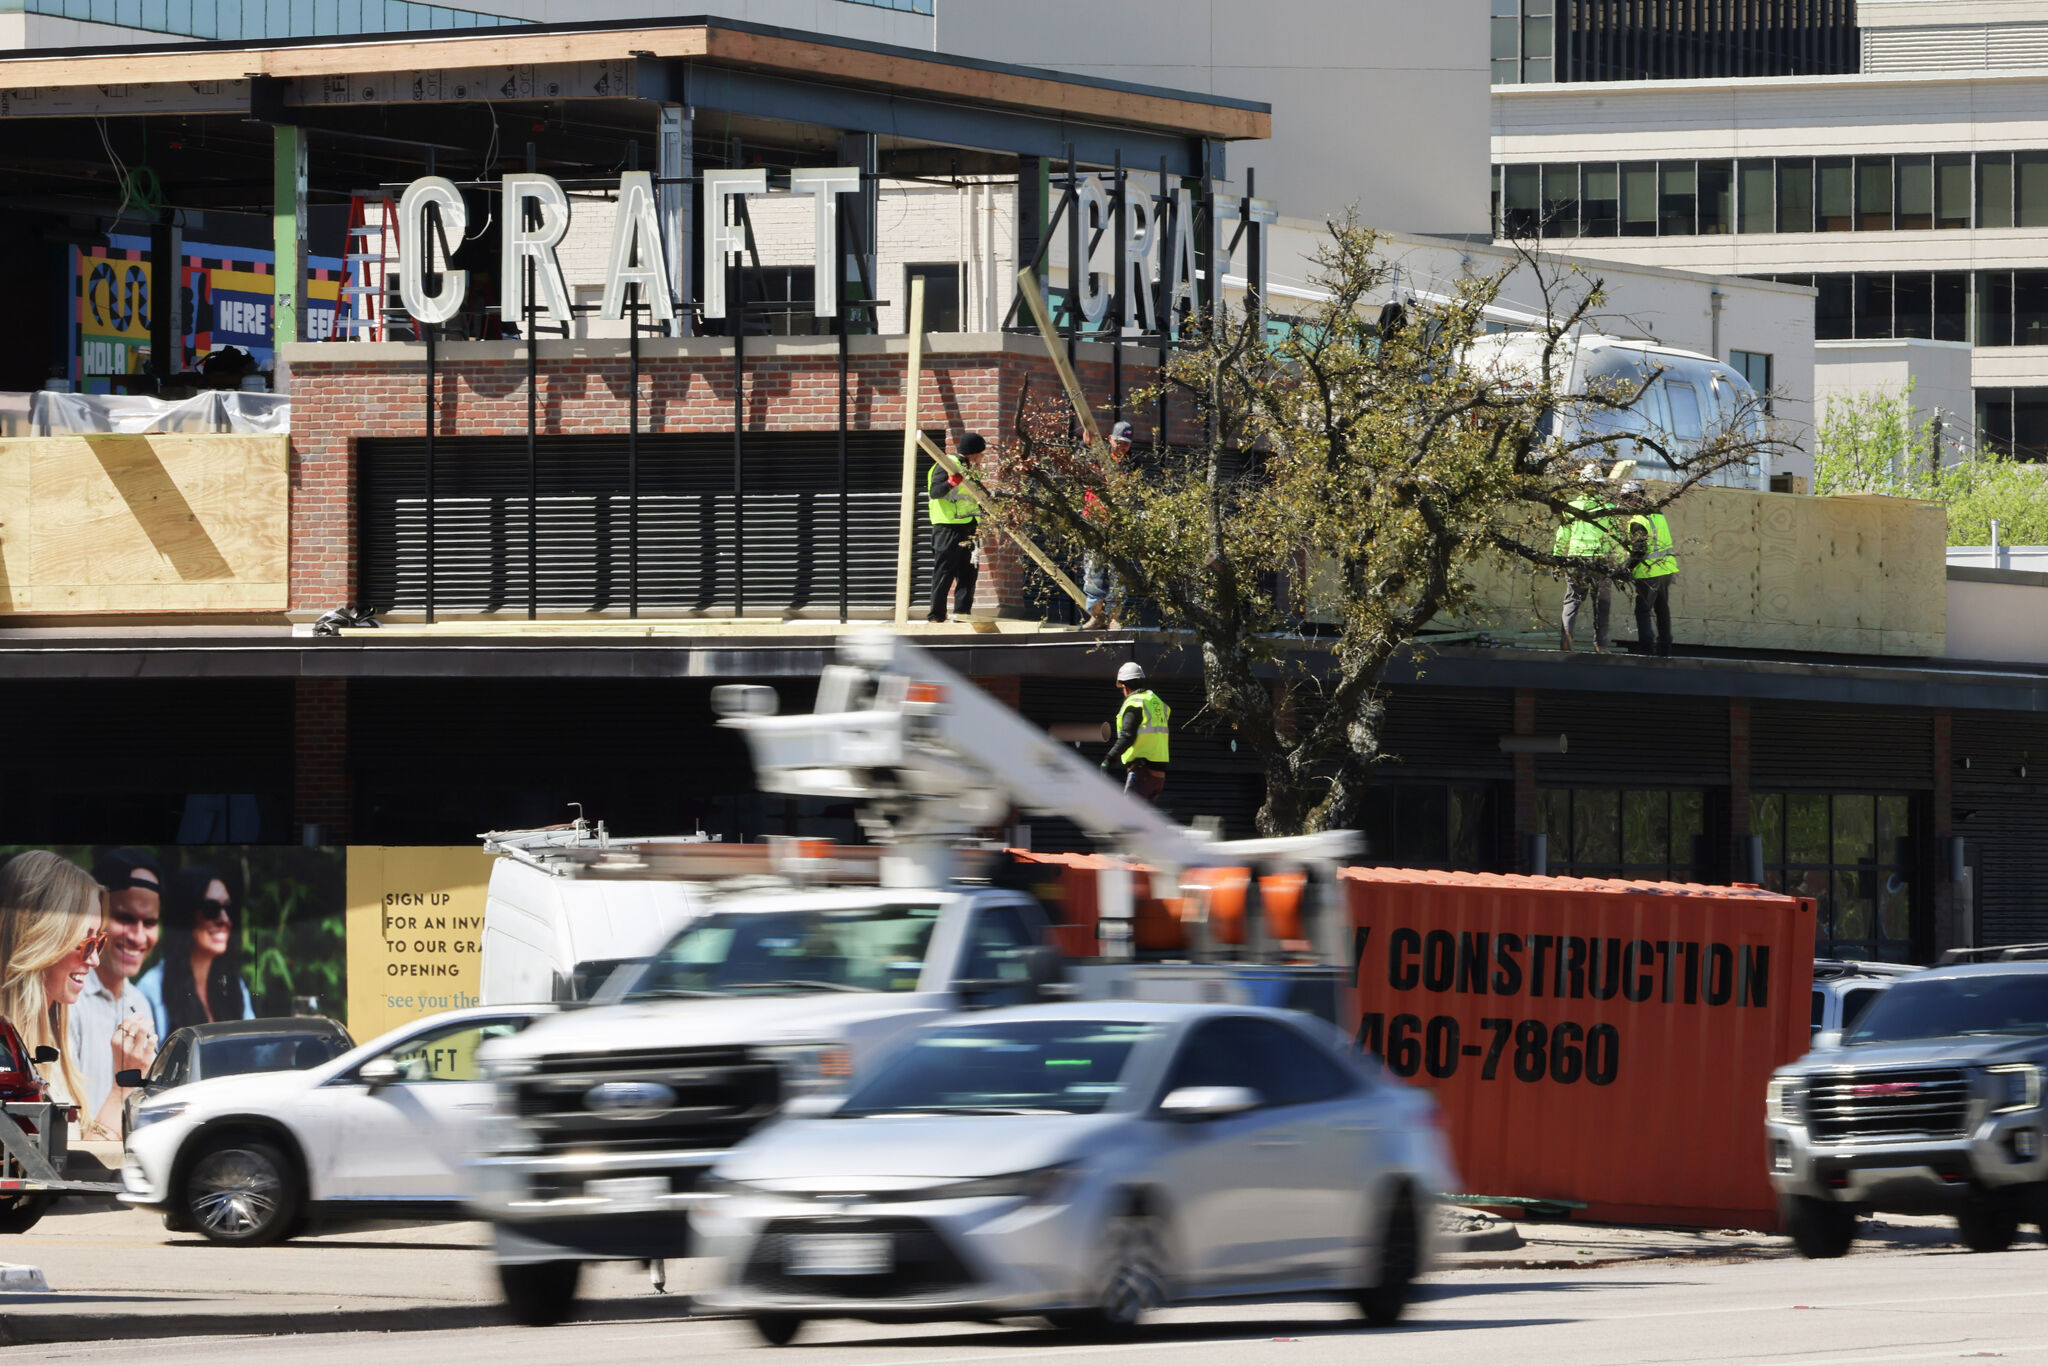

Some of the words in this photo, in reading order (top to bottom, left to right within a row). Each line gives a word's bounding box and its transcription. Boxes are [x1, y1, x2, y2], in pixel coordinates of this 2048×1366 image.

[401, 166, 861, 324] CRAFT
[1076, 176, 1278, 342] CRAFT
[220, 300, 266, 336] HERE
[83, 341, 126, 375] HOLA
[386, 893, 424, 906] SIGN
[431, 893, 450, 906] UP
[386, 917, 417, 929] FOR
[424, 917, 446, 929] AN
[386, 940, 407, 953] TO
[414, 940, 447, 953] OUR
[387, 964, 459, 977] OPENING
[1388, 927, 1770, 1008] CONSTRUCTION
[387, 995, 414, 1008] see
[418, 995, 448, 1012] you
